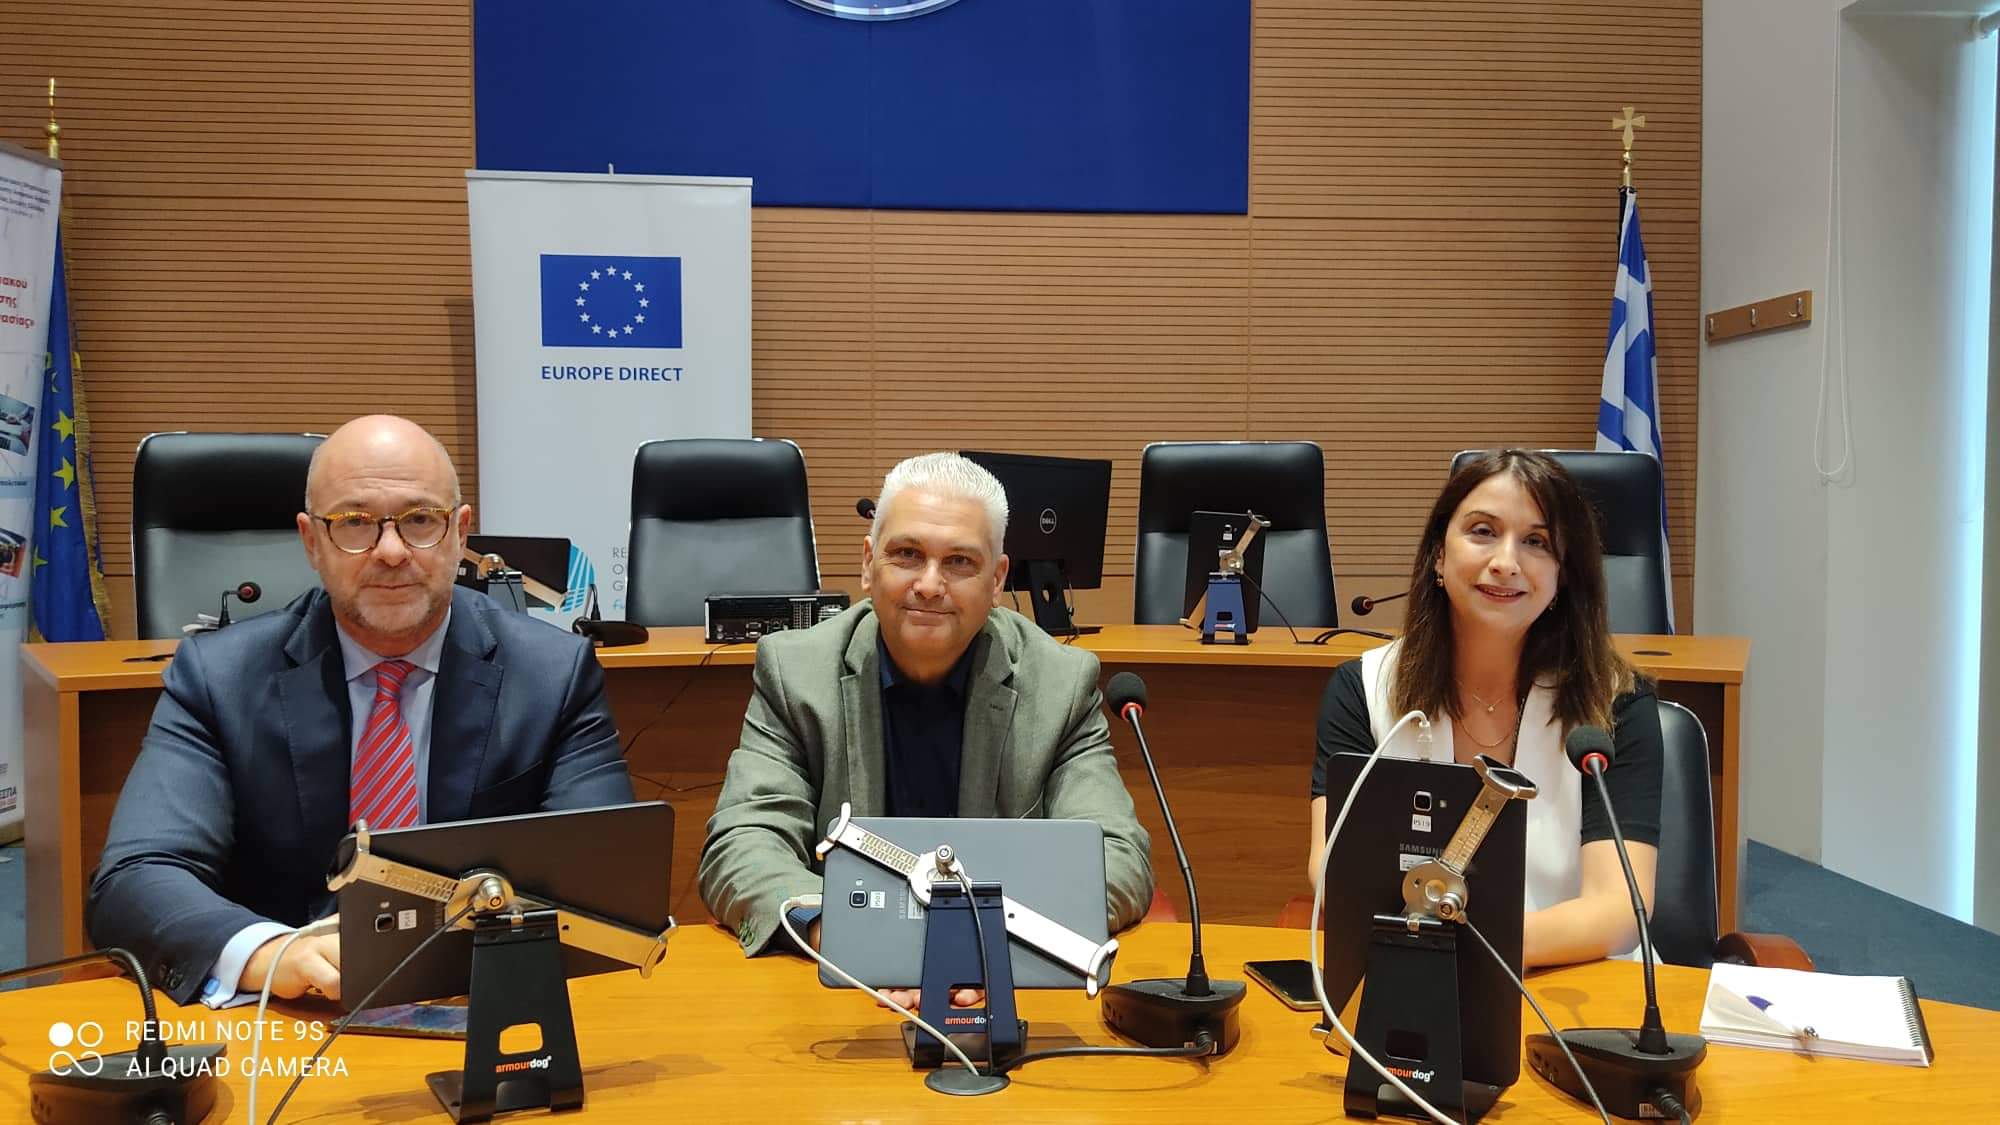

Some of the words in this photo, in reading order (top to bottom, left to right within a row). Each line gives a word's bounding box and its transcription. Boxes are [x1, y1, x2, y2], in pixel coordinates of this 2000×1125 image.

[541, 366, 613, 381] EUROPE
[619, 367, 683, 382] DIRECT
[612, 546, 627, 559] RE
[944, 1015, 987, 1025] armourdo
